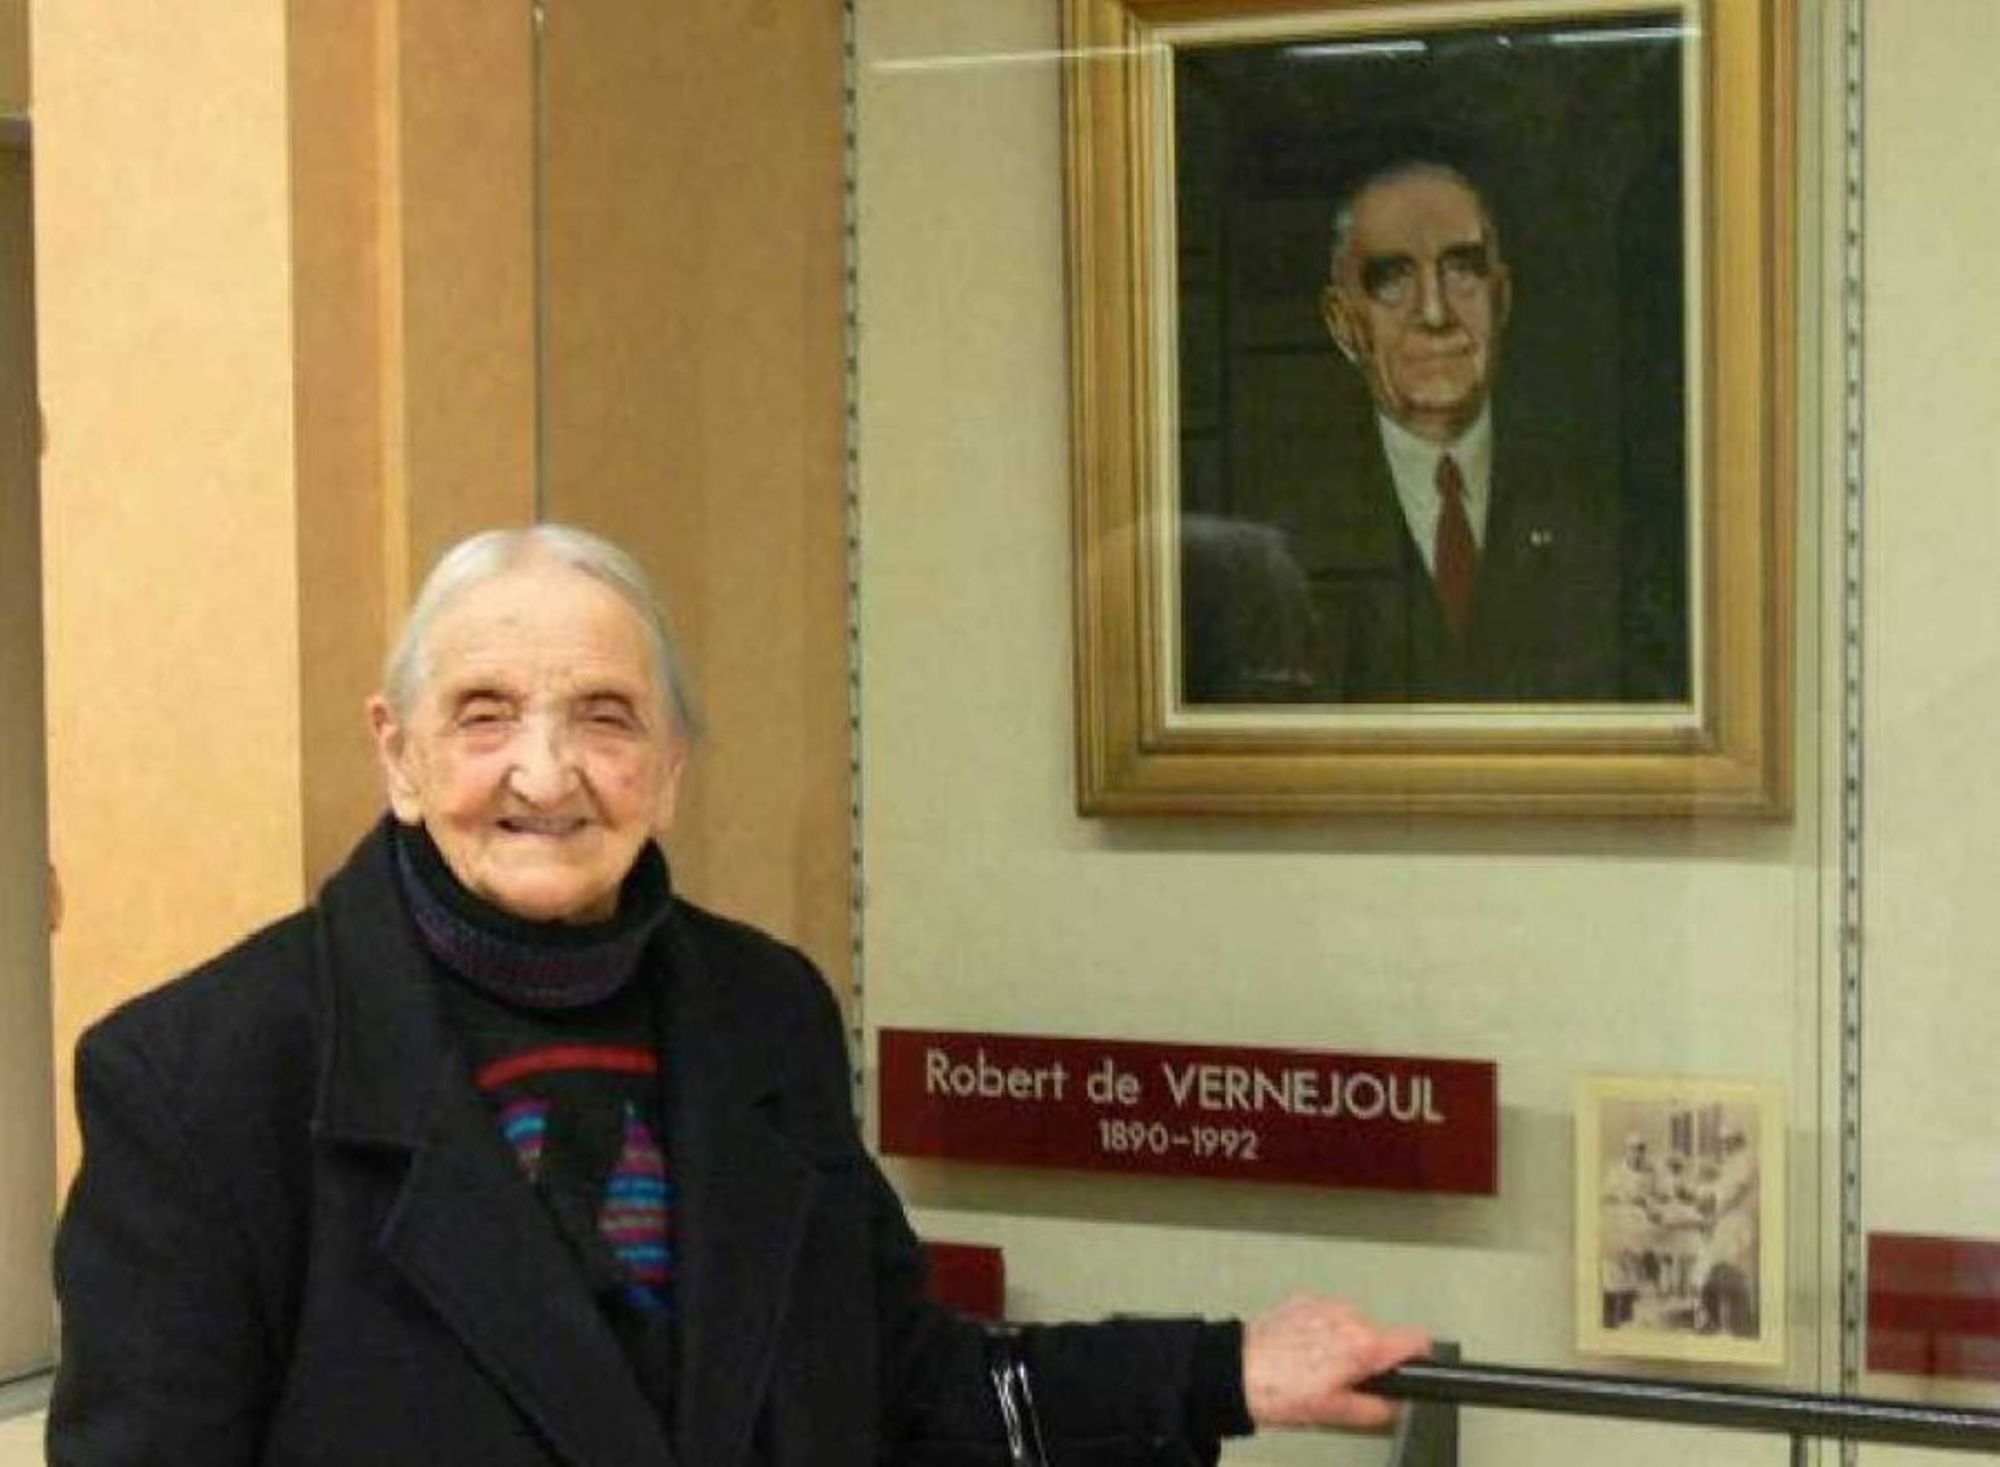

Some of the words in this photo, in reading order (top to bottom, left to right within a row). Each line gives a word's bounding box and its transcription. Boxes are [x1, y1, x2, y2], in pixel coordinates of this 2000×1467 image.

[925, 1048, 1066, 1100] Robert
[1087, 1058, 1141, 1105] de
[1162, 1061, 1446, 1123] VERNEJOUL
[1099, 1119, 1259, 1160] 1890-1992
